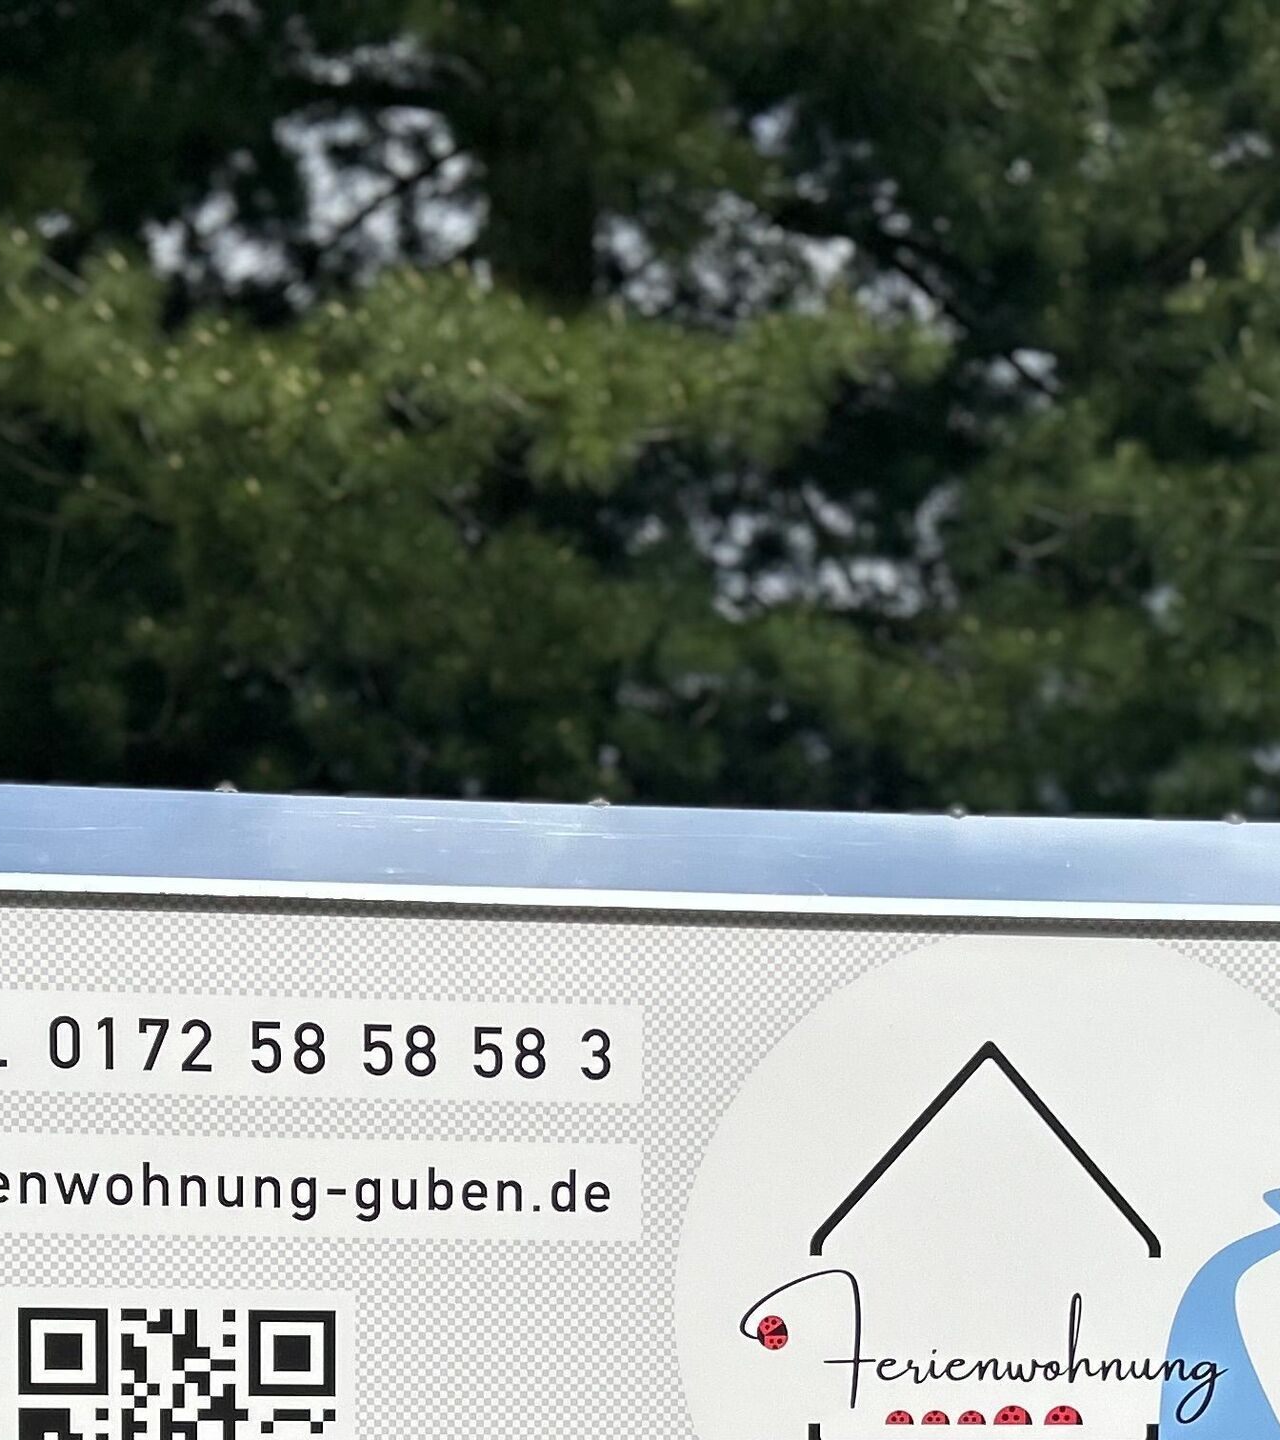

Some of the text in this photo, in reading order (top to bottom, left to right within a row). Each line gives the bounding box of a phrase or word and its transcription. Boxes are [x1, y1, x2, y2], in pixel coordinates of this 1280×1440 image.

[49, 1015, 213, 1073] 0172
[251, 1020, 326, 1075] 58
[363, 1023, 437, 1077] 58
[473, 1026, 546, 1080] 58
[580, 1028, 611, 1081] 3
[740, 1269, 1228, 1424] Ferienwohnung
